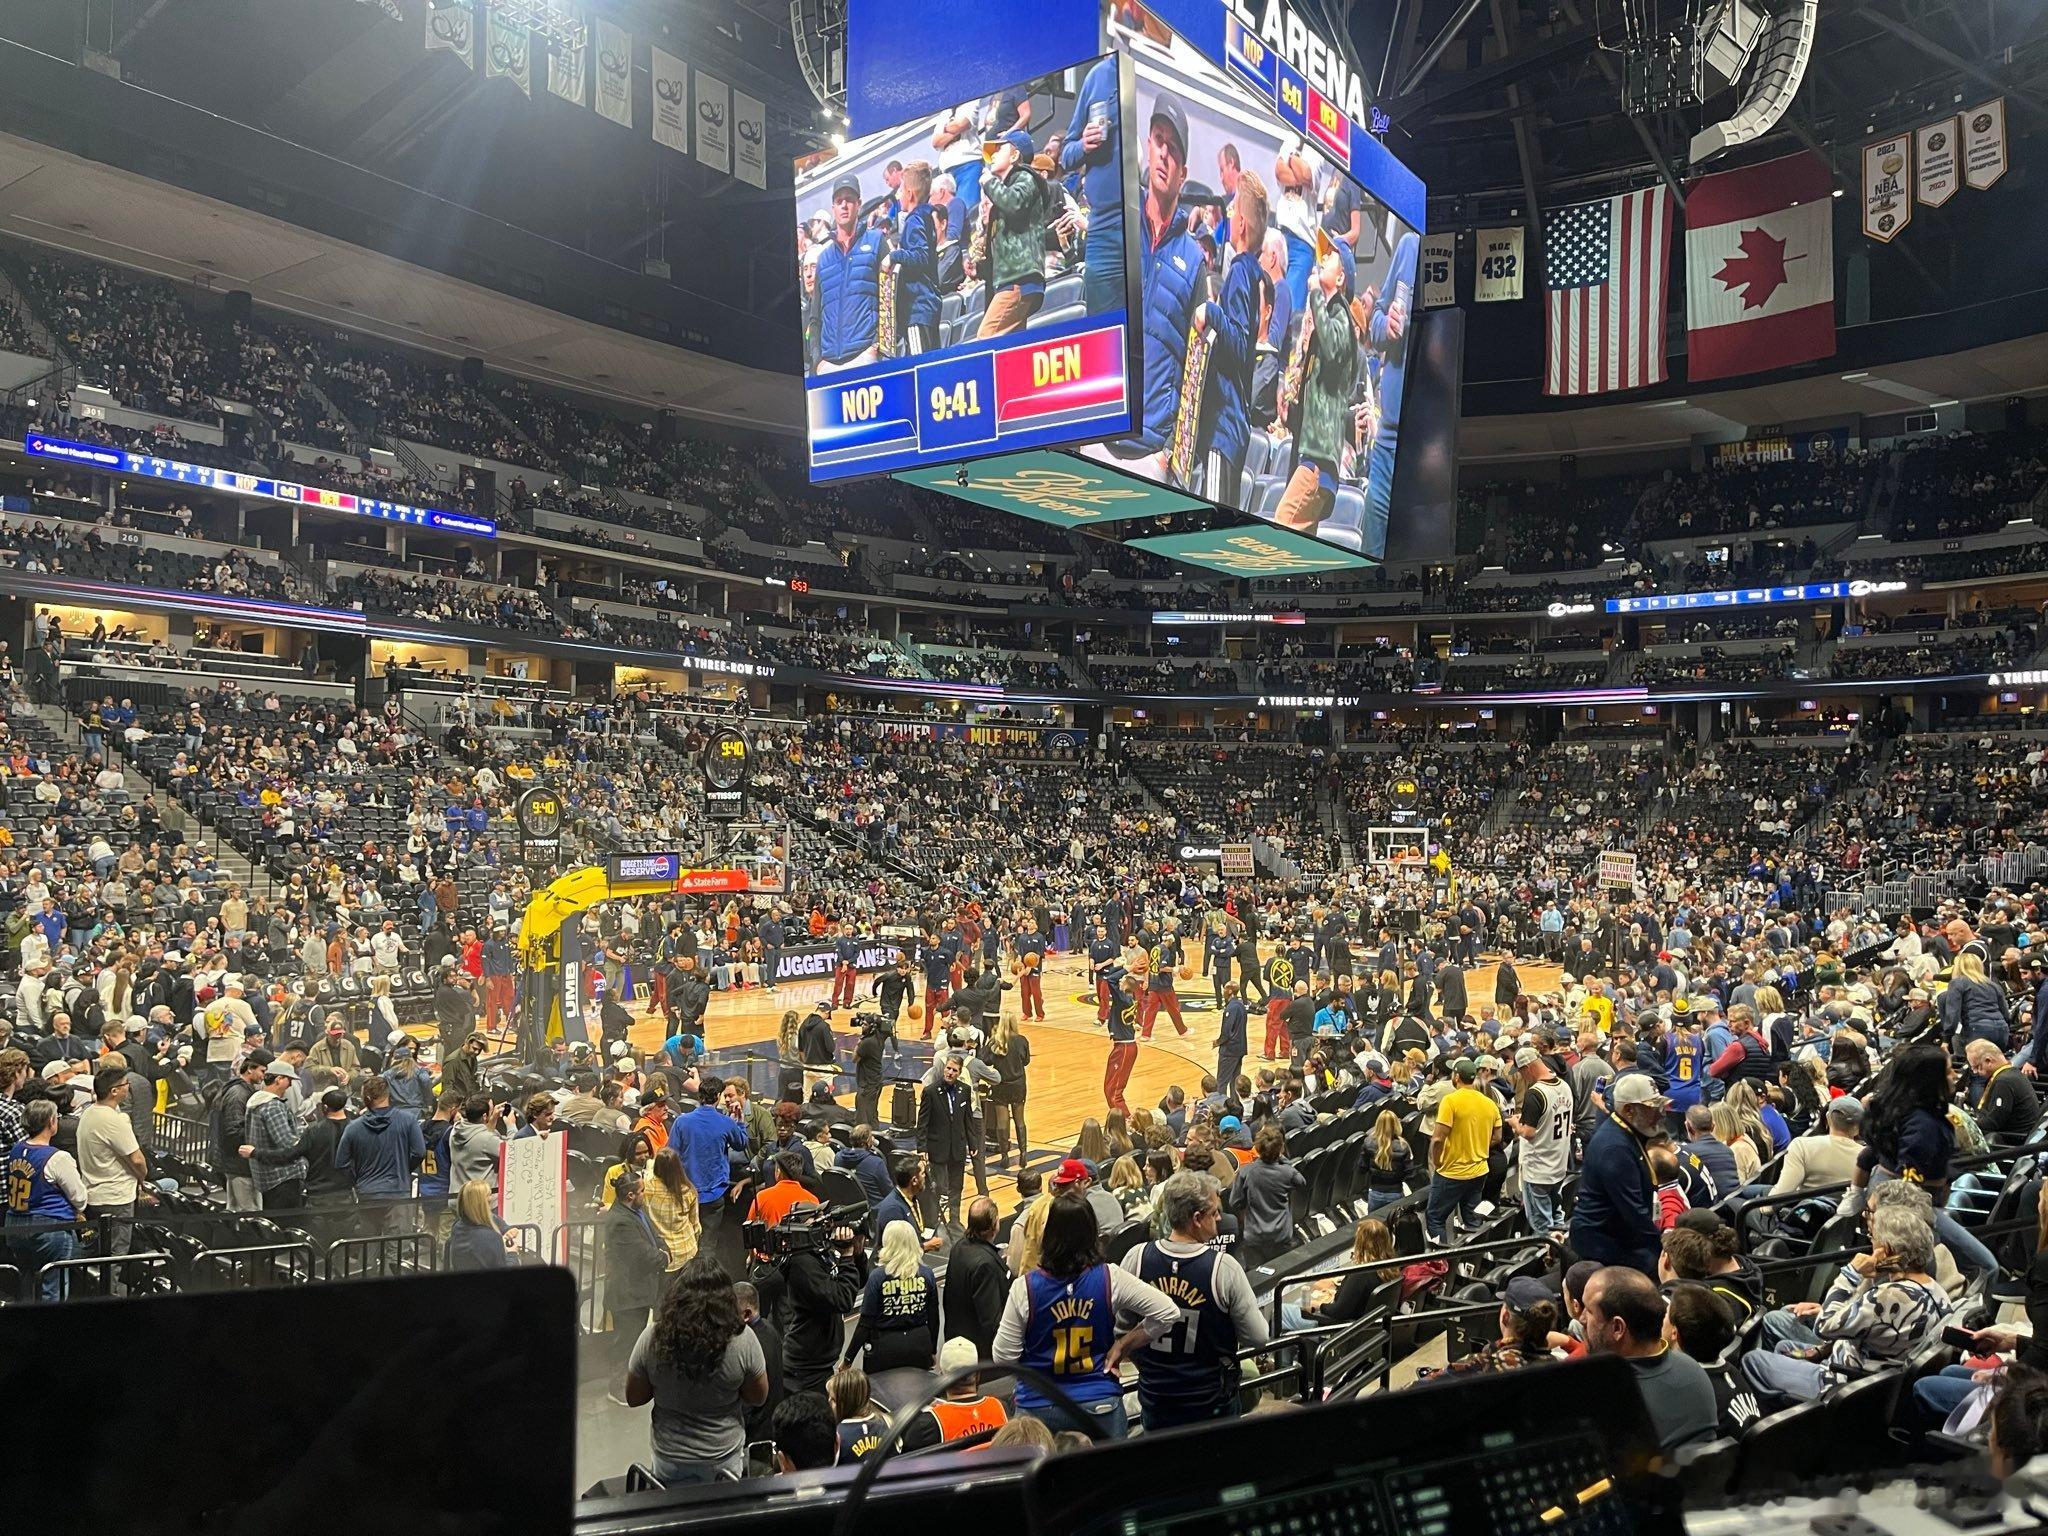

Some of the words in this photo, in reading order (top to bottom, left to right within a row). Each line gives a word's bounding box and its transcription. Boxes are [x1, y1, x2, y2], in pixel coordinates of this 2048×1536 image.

[1243, 32, 1263, 67] NOP
[1261, 0, 1366, 129] ARENA
[1282, 77, 1302, 114] 9:41
[1320, 100, 1337, 133] DEN
[1370, 106, 1390, 132] Ball
[1877, 143, 1896, 157] 2023
[1875, 178, 1898, 195] NBA
[1868, 188, 1905, 204] CHAMPIONS
[1489, 242, 1511, 252] MOE
[1482, 255, 1517, 279] 432
[1032, 344, 1081, 387] DEN
[842, 385, 883, 423] NOP
[931, 380, 980, 421] 9:41
[85, 407, 101, 415] 301
[1720, 441, 1754, 457] MILE
[235, 475, 258, 490] NOP
[930, 470, 1151, 505] Ball
[320, 492, 339, 506] DEN
[1001, 493, 1101, 517] Arena
[122, 533, 139, 543] 260
[791, 579, 808, 592] 6:53
[683, 657, 692, 668] A
[694, 657, 754, 675] THREE-ROW
[756, 666, 776, 677] SUV
[1988, 674, 2000, 685] A
[1258, 697, 1267, 706] A
[1270, 697, 1334, 706] THREE-ROW
[1337, 697, 1360, 706] SUV
[970, 728, 1001, 745] MILE
[721, 741, 743, 756] 9:40
[717, 792, 742, 800] TISSOT
[532, 801, 555, 815] 9:40
[621, 860, 642, 868] NUGGETS
[621, 867, 655, 876] DESERVE
[1602, 862, 1633, 873] ALTITUDE
[1602, 871, 1632, 881] WARNING
[855, 948, 885, 968] ANS
[565, 962, 577, 1018] UMB
[290, 1021, 304, 1038] 27
[1679, 1057, 1692, 1080] 6
[1553, 1110, 1571, 1140] 27
[9, 1175, 31, 1211] 32
[882, 1277, 925, 1295] argus
[1150, 1277, 1206, 1307] URRAY
[883, 1293, 926, 1307] EVENT
[1766, 1293, 1776, 1305] 4
[883, 1302, 926, 1316] STAFF
[1050, 1298, 1094, 1323] JOKIĆ
[1053, 1326, 1094, 1374] 15
[852, 1436, 881, 1457] BRAU
